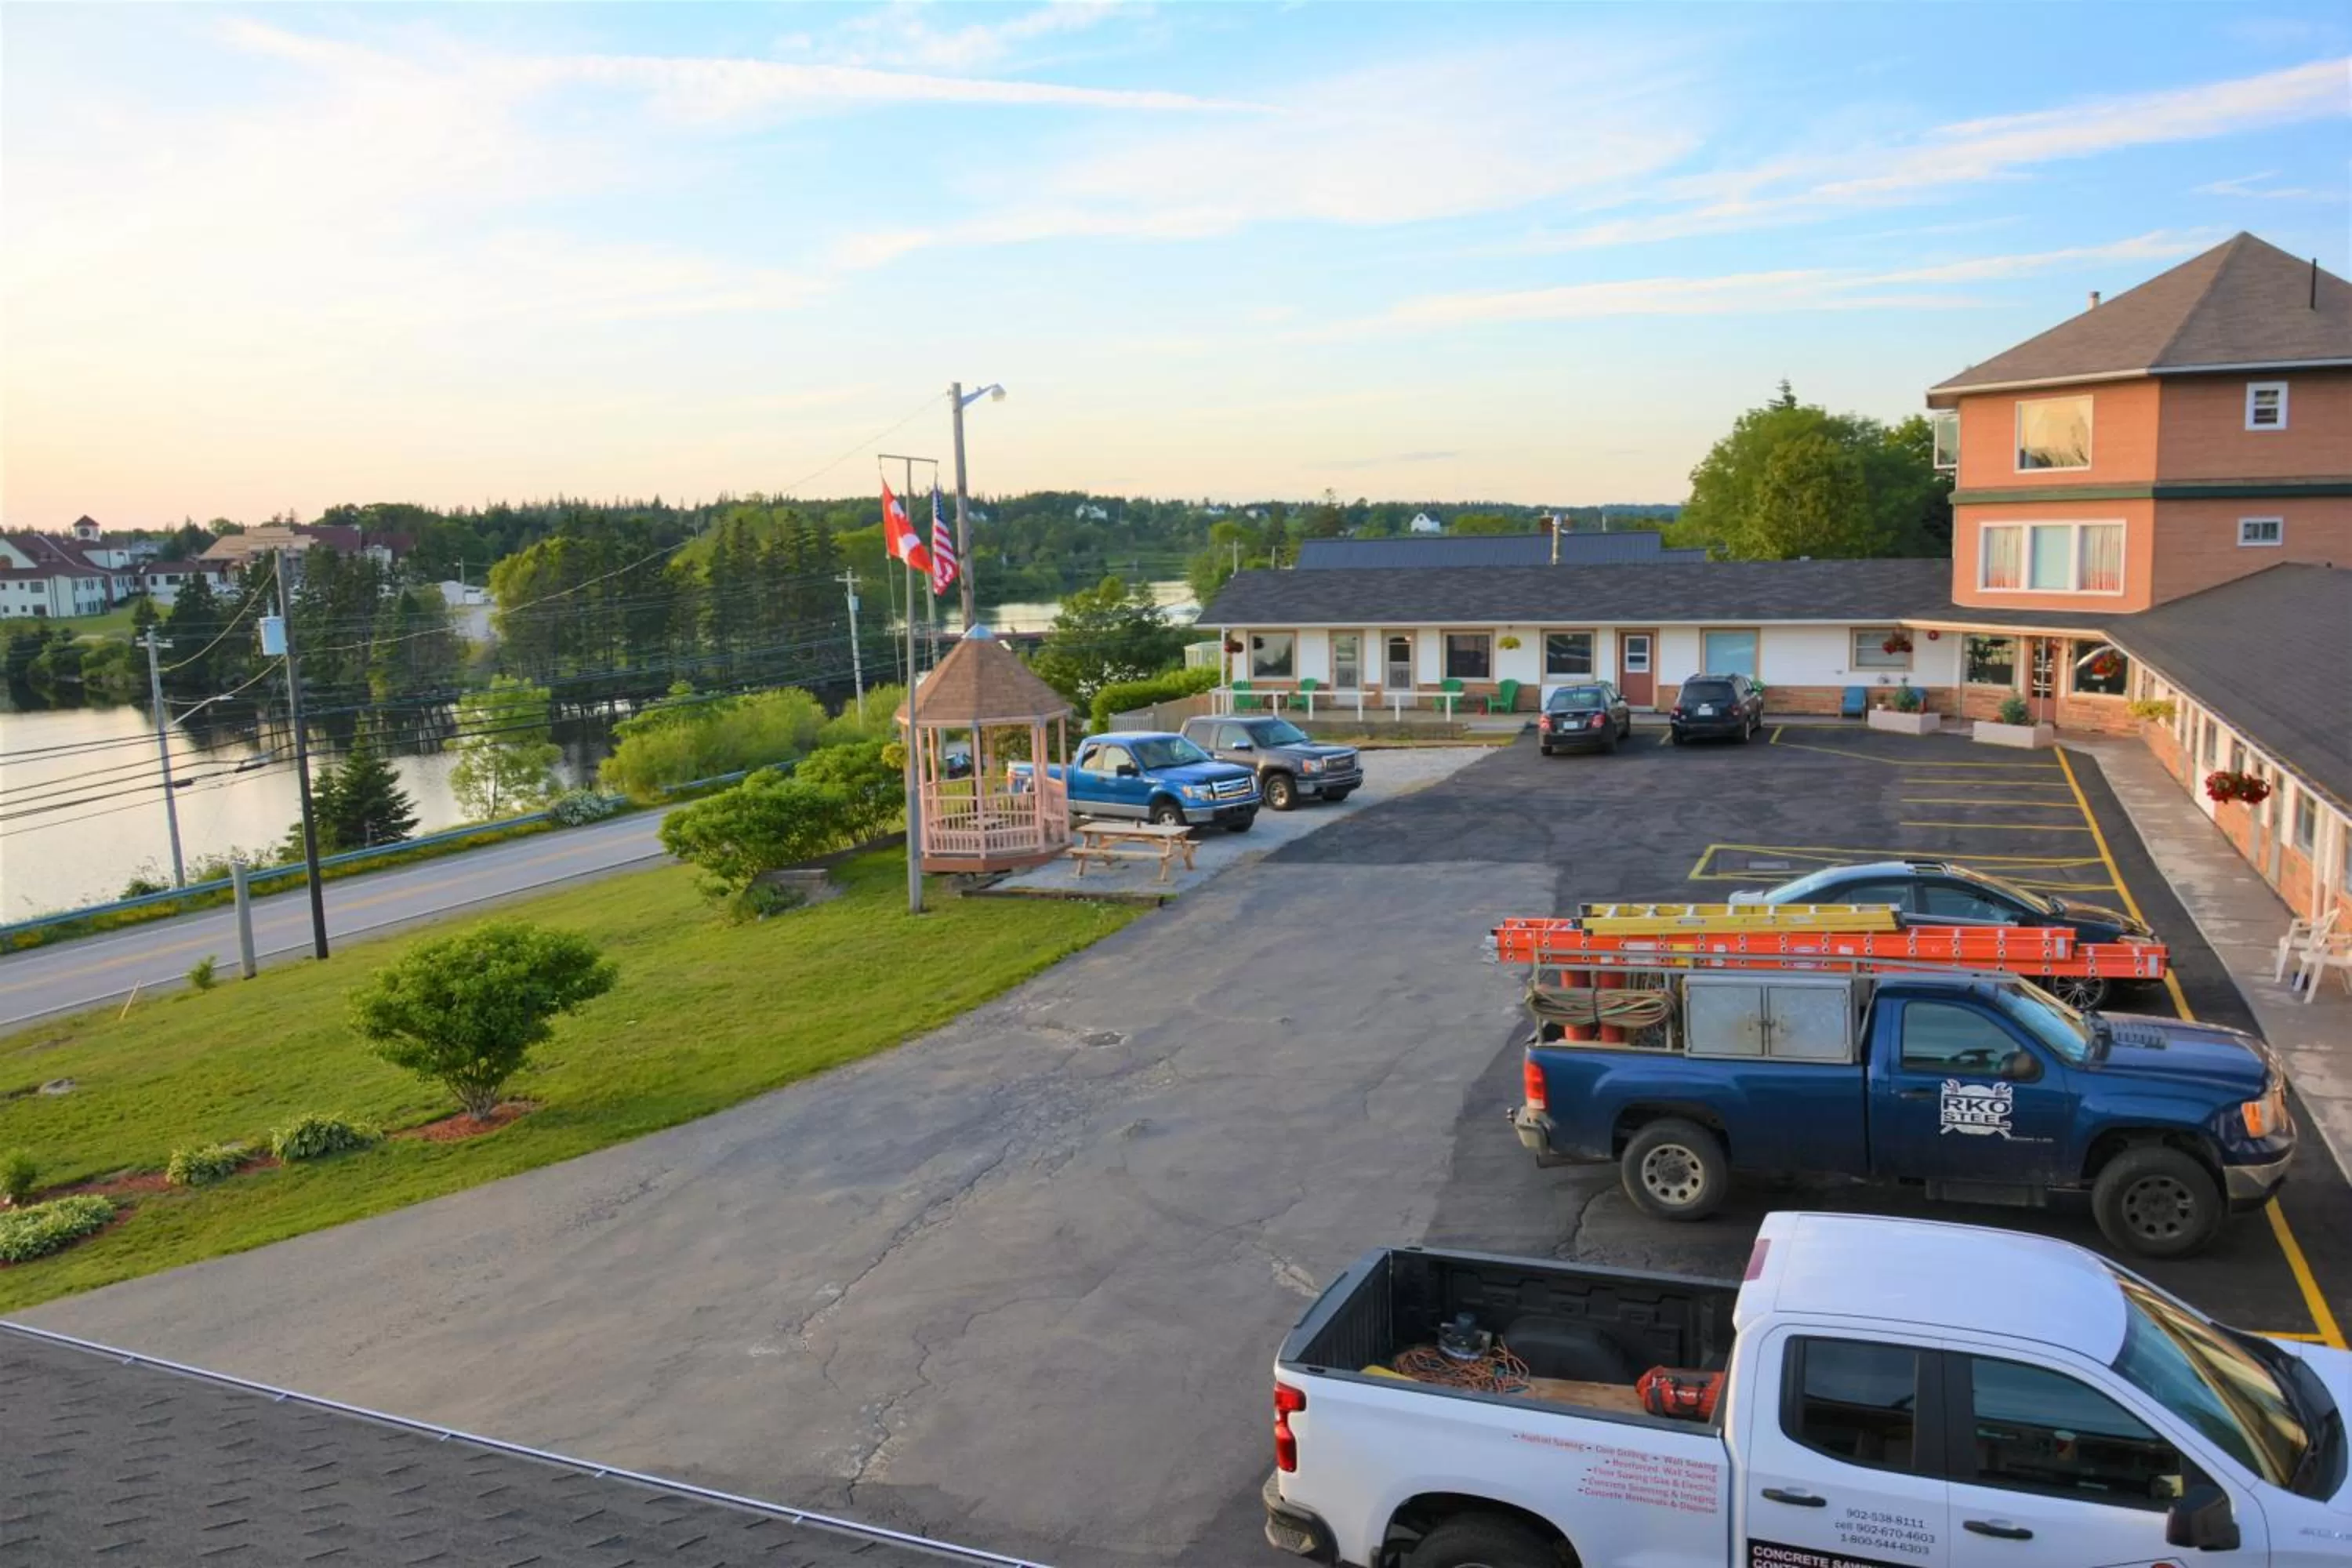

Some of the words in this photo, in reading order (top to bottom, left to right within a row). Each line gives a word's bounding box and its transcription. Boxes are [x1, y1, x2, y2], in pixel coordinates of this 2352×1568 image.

[1944, 1098, 2009, 1114] RKO
[1944, 1112, 2009, 1124] STEEL
[1752, 1545, 1829, 1568] CONCRETE
